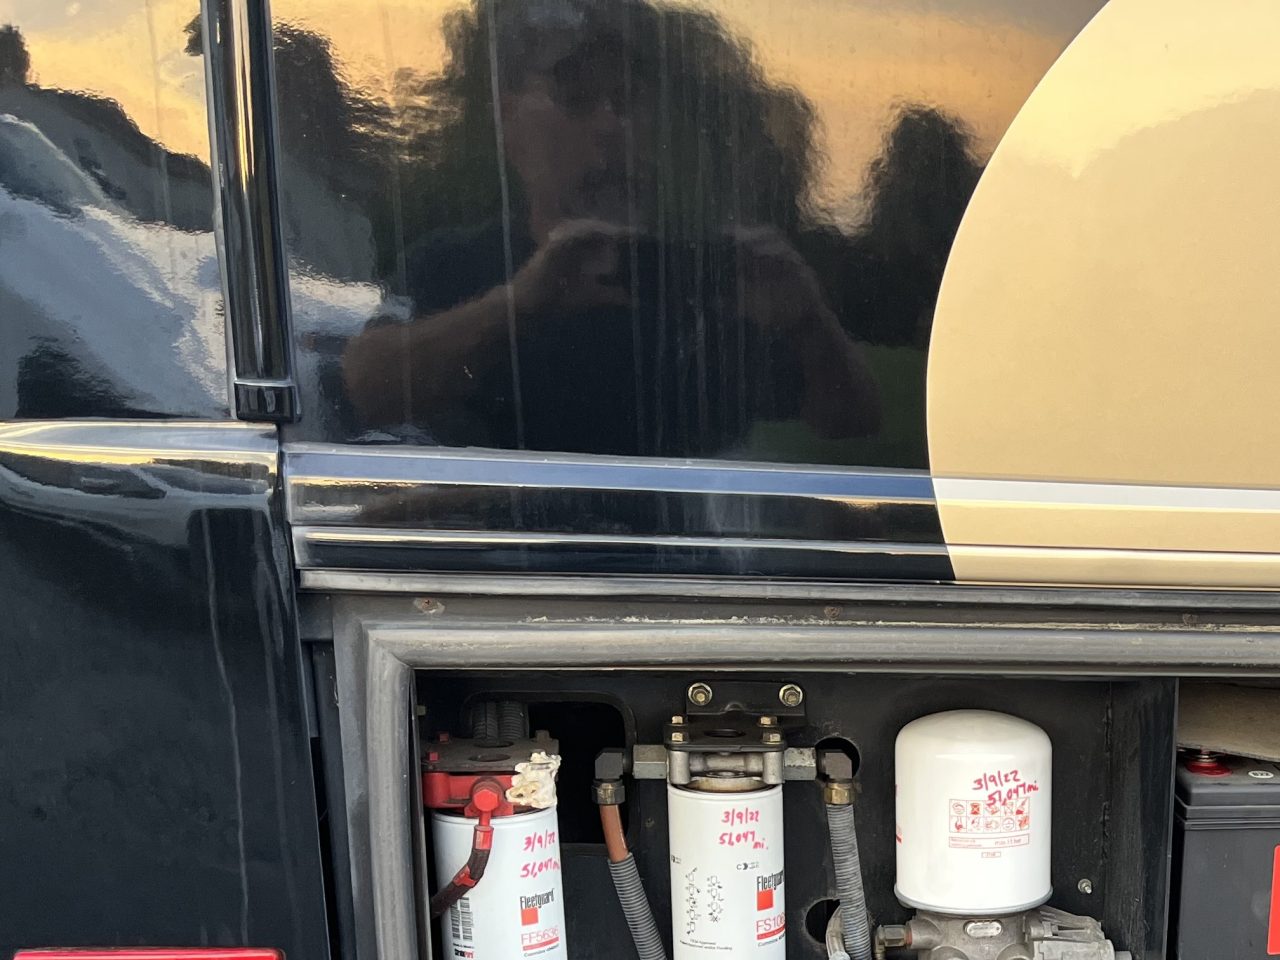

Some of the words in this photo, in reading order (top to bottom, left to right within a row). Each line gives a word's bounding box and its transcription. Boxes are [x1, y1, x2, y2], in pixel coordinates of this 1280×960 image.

[972, 769, 1021, 791] 3/9/22
[721, 807, 760, 827] 3/9/22
[522, 829, 556, 852] 3/9/22
[719, 830, 756, 847] 51,047
[519, 888, 555, 910] Fleetguard
